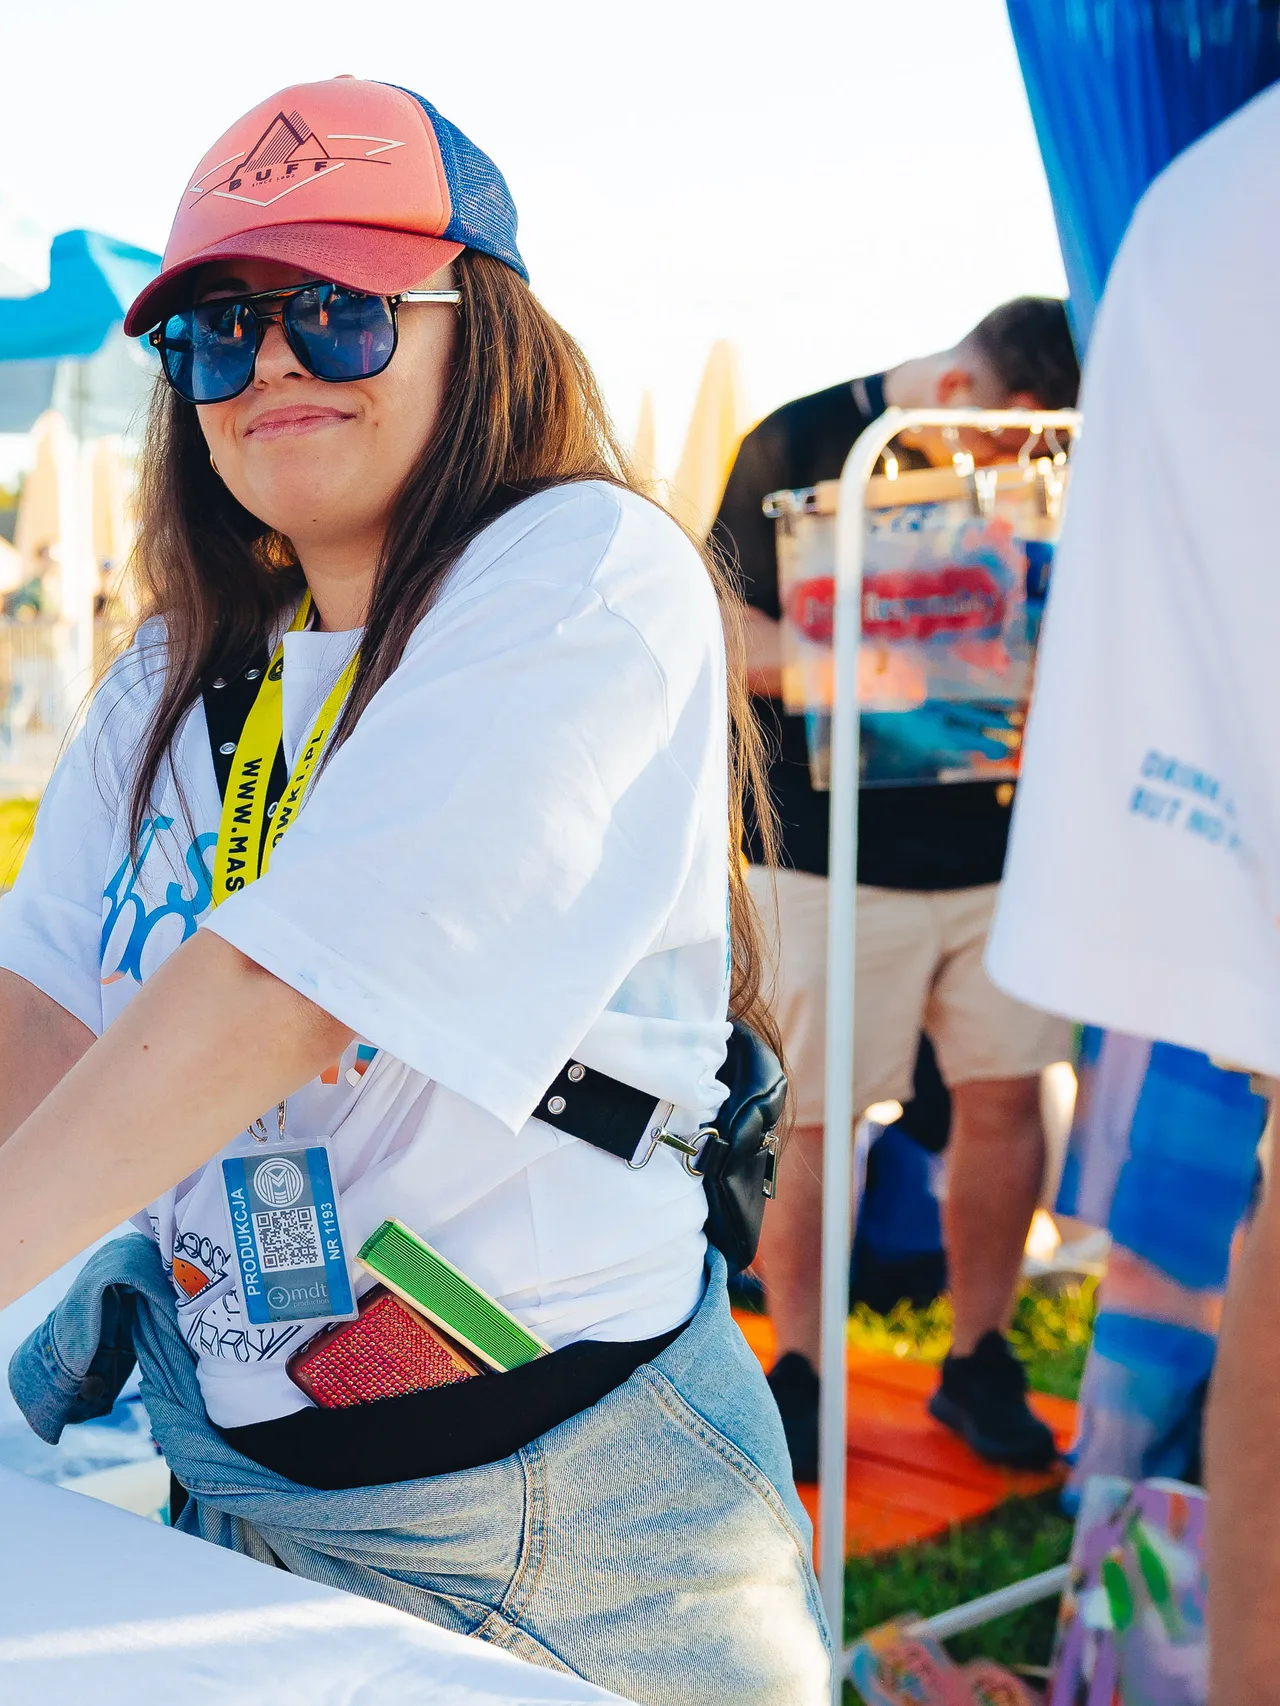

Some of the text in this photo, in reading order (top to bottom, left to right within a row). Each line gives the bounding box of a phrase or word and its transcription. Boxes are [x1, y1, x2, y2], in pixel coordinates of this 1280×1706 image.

[228, 161, 328, 192] BUFF
[230, 1187, 261, 1297] PRODUKCJA
[322, 1202, 340, 1260] NR 1193
[291, 1281, 328, 1301] mdt
[293, 1298, 330, 1309] production
